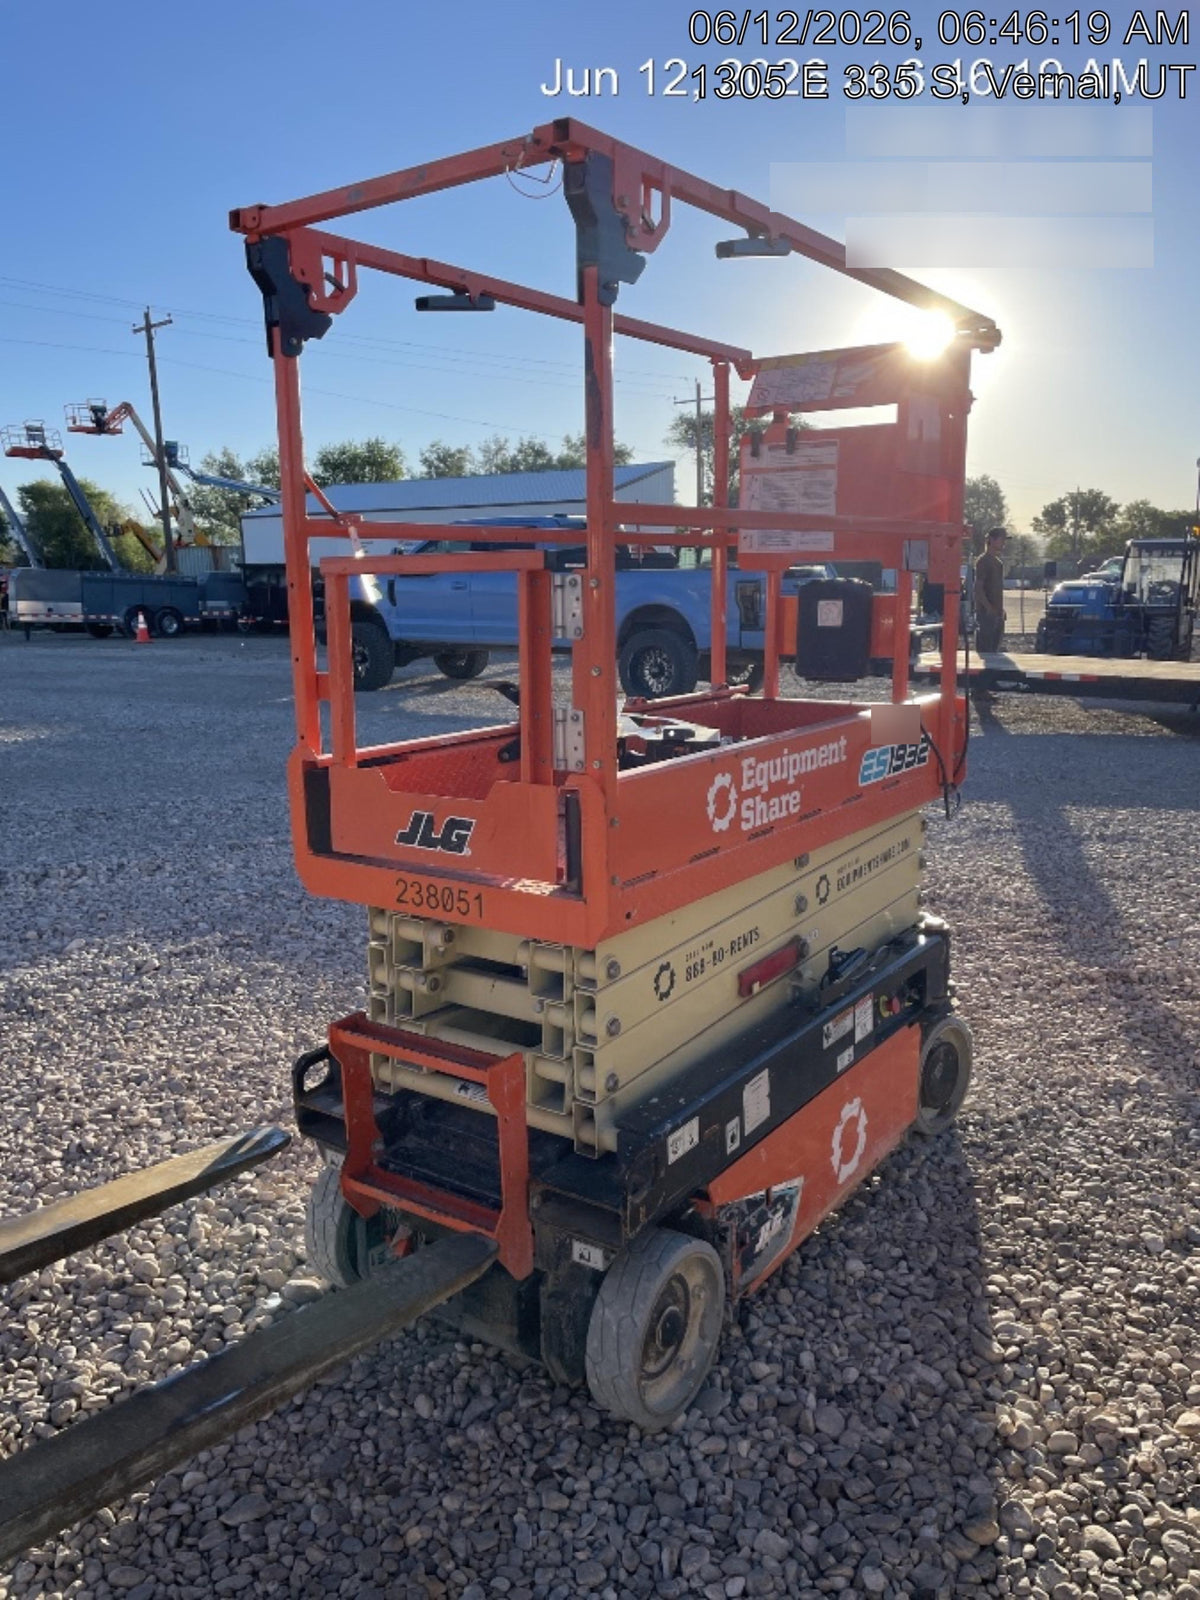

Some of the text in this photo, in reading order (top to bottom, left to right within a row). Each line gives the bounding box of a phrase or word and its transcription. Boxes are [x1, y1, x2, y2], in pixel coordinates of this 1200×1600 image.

[741, 736, 848, 793] Equipment
[741, 789, 801, 831] Share
[395, 810, 477, 856] JLG
[395, 878, 483, 918] 238051
